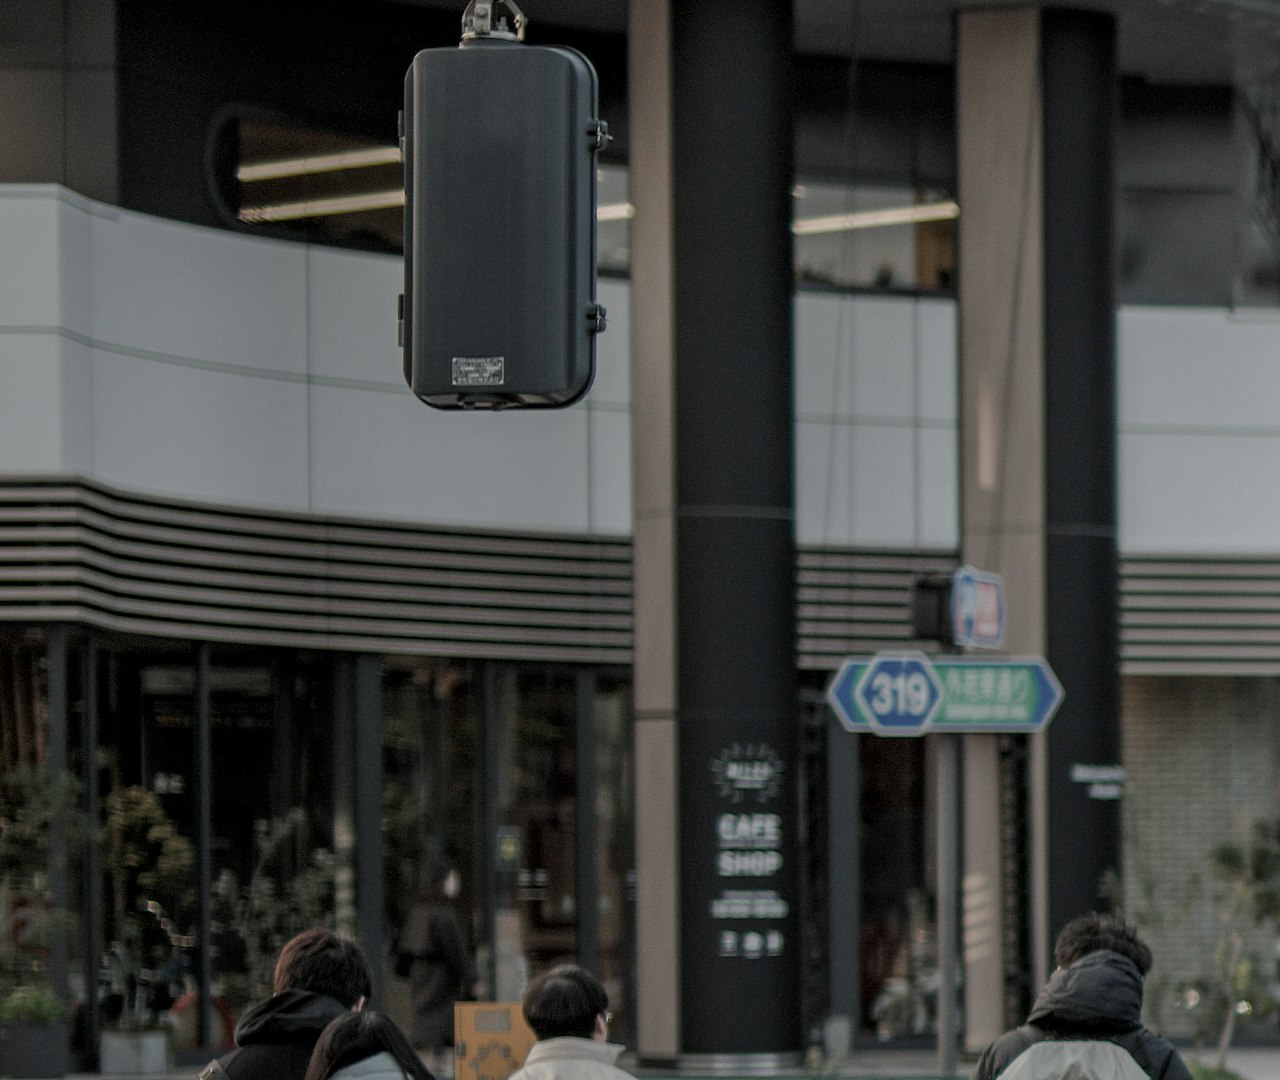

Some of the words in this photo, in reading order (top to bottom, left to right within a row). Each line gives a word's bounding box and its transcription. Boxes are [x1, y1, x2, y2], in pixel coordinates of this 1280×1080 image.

[871, 671, 930, 717] 319
[718, 811, 782, 840] CAFE
[718, 850, 784, 877] SHOP
